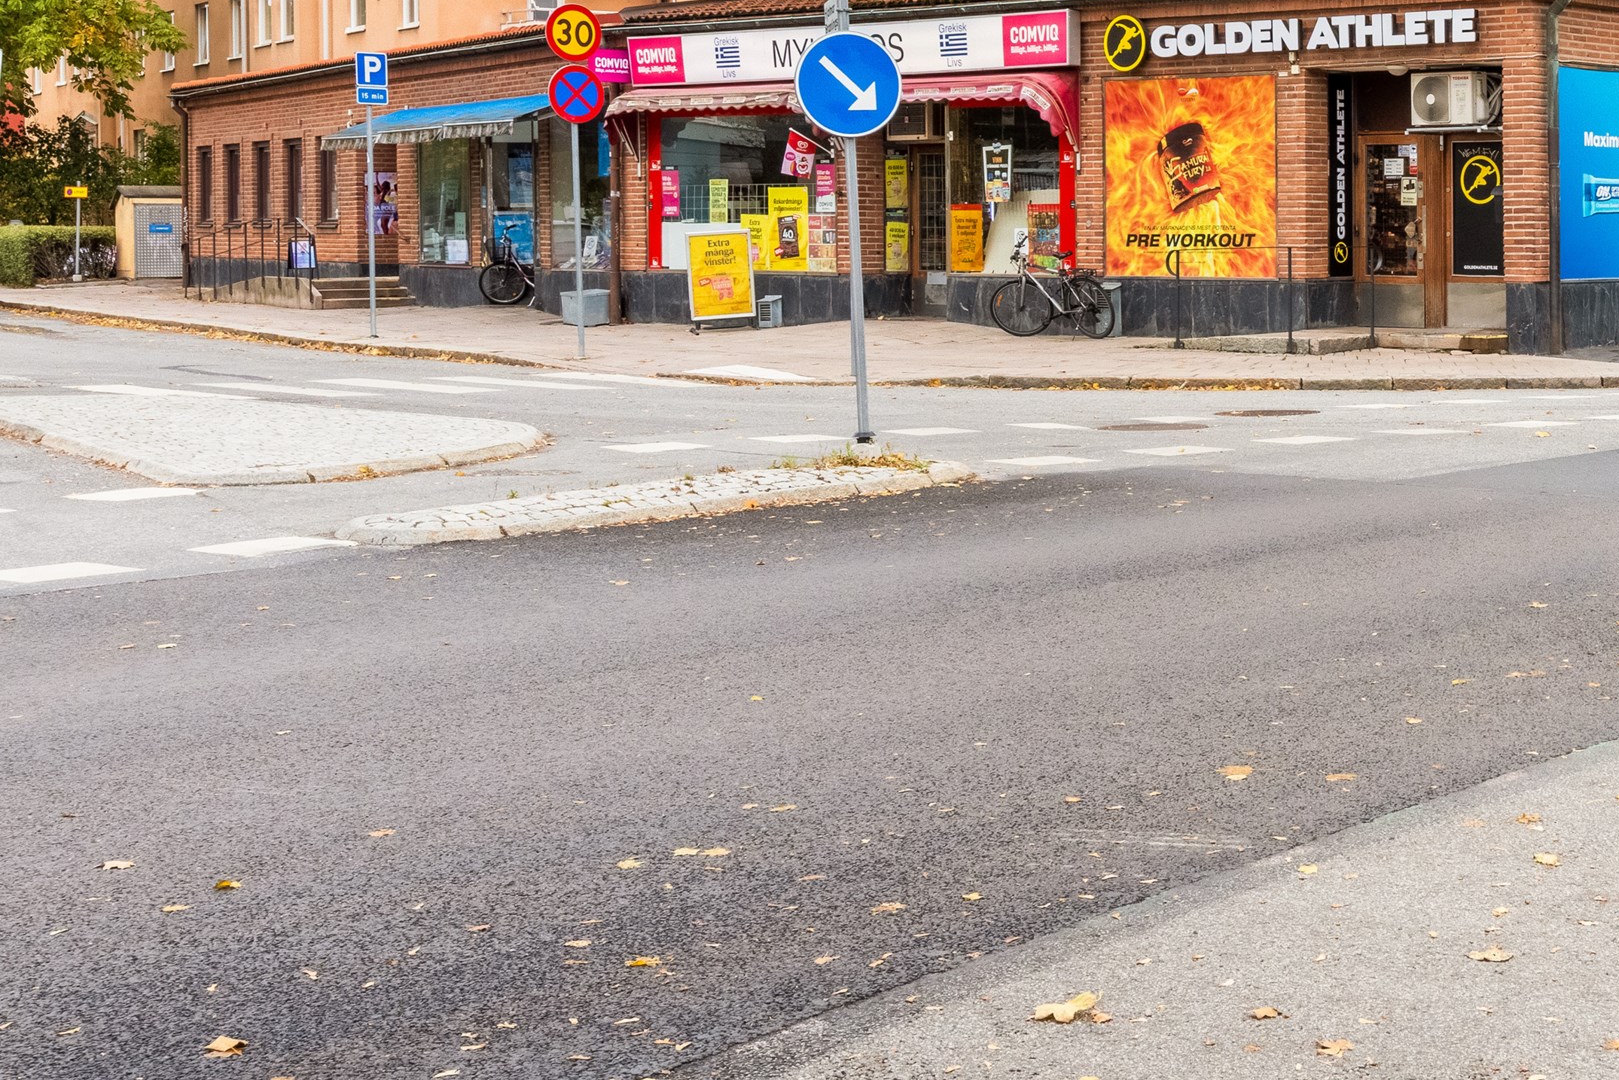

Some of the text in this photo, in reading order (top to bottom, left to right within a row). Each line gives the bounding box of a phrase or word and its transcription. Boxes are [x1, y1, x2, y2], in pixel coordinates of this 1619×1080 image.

[556, 18, 594, 48] 30
[938, 22, 967, 33] Grekisk
[1009, 23, 1059, 44] COMVIQ
[1150, 8, 1476, 58] GOLDEN ATHLETE
[714, 36, 739, 47] Grekisk
[594, 56, 629, 70] COMVIQ
[636, 47, 677, 65] COMVIQ
[947, 57, 963, 68] Livs
[364, 55, 382, 83] P
[722, 69, 736, 79] Livs
[361, 92, 384, 100] 15 min
[1336, 89, 1346, 240] GOLDEN ATHLETE
[1183, 165, 1204, 180] FURY
[707, 239, 730, 248] Extra
[1126, 232, 1256, 248] PRE WORKOUT
[705, 248, 734, 257] många
[704, 256, 736, 266] vinster!
